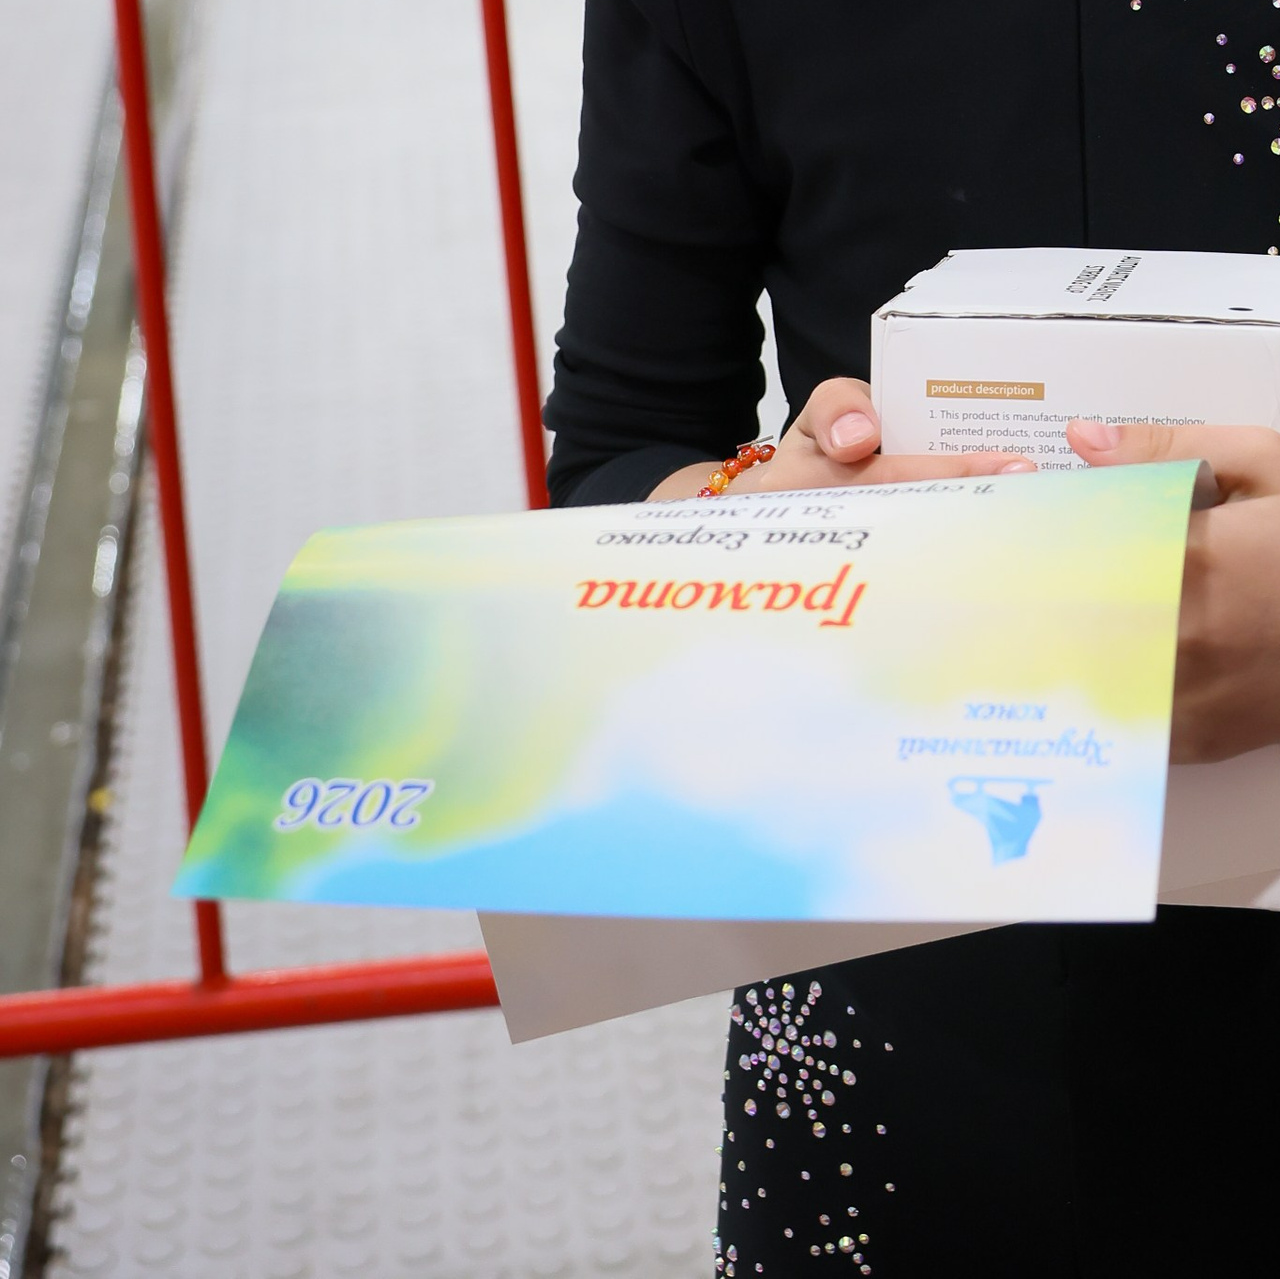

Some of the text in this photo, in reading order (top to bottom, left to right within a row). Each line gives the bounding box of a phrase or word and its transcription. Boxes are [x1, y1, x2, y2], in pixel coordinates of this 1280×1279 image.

[1071, 265, 1106, 285] STIRRING
[1086, 255, 1142, 302] AUTOMATIC MAGNETIC
[931, 384, 1035, 397] product description
[929, 410, 937, 419] 1.
[940, 410, 960, 420] This
[962, 411, 1000, 422] product
[1002, 411, 1010, 421] is
[1012, 411, 1080, 423] manufactured
[1082, 413, 1103, 424] with
[1105, 415, 1149, 426] patented
[940, 426, 1067, 439] patented products, counte
[928, 442, 937, 451] 2.
[939, 442, 959, 452] This
[961, 443, 999, 453] product
[1001, 444, 1035, 455] adopts
[1038, 444, 1055, 454] 304
[635, 504, 844, 521] За III место
[596, 526, 870, 551] Елена Егоренко
[575, 562, 867, 628] Грамота
[898, 726, 1114, 766] Хрустальный
[276, 779, 432, 829] 2026
